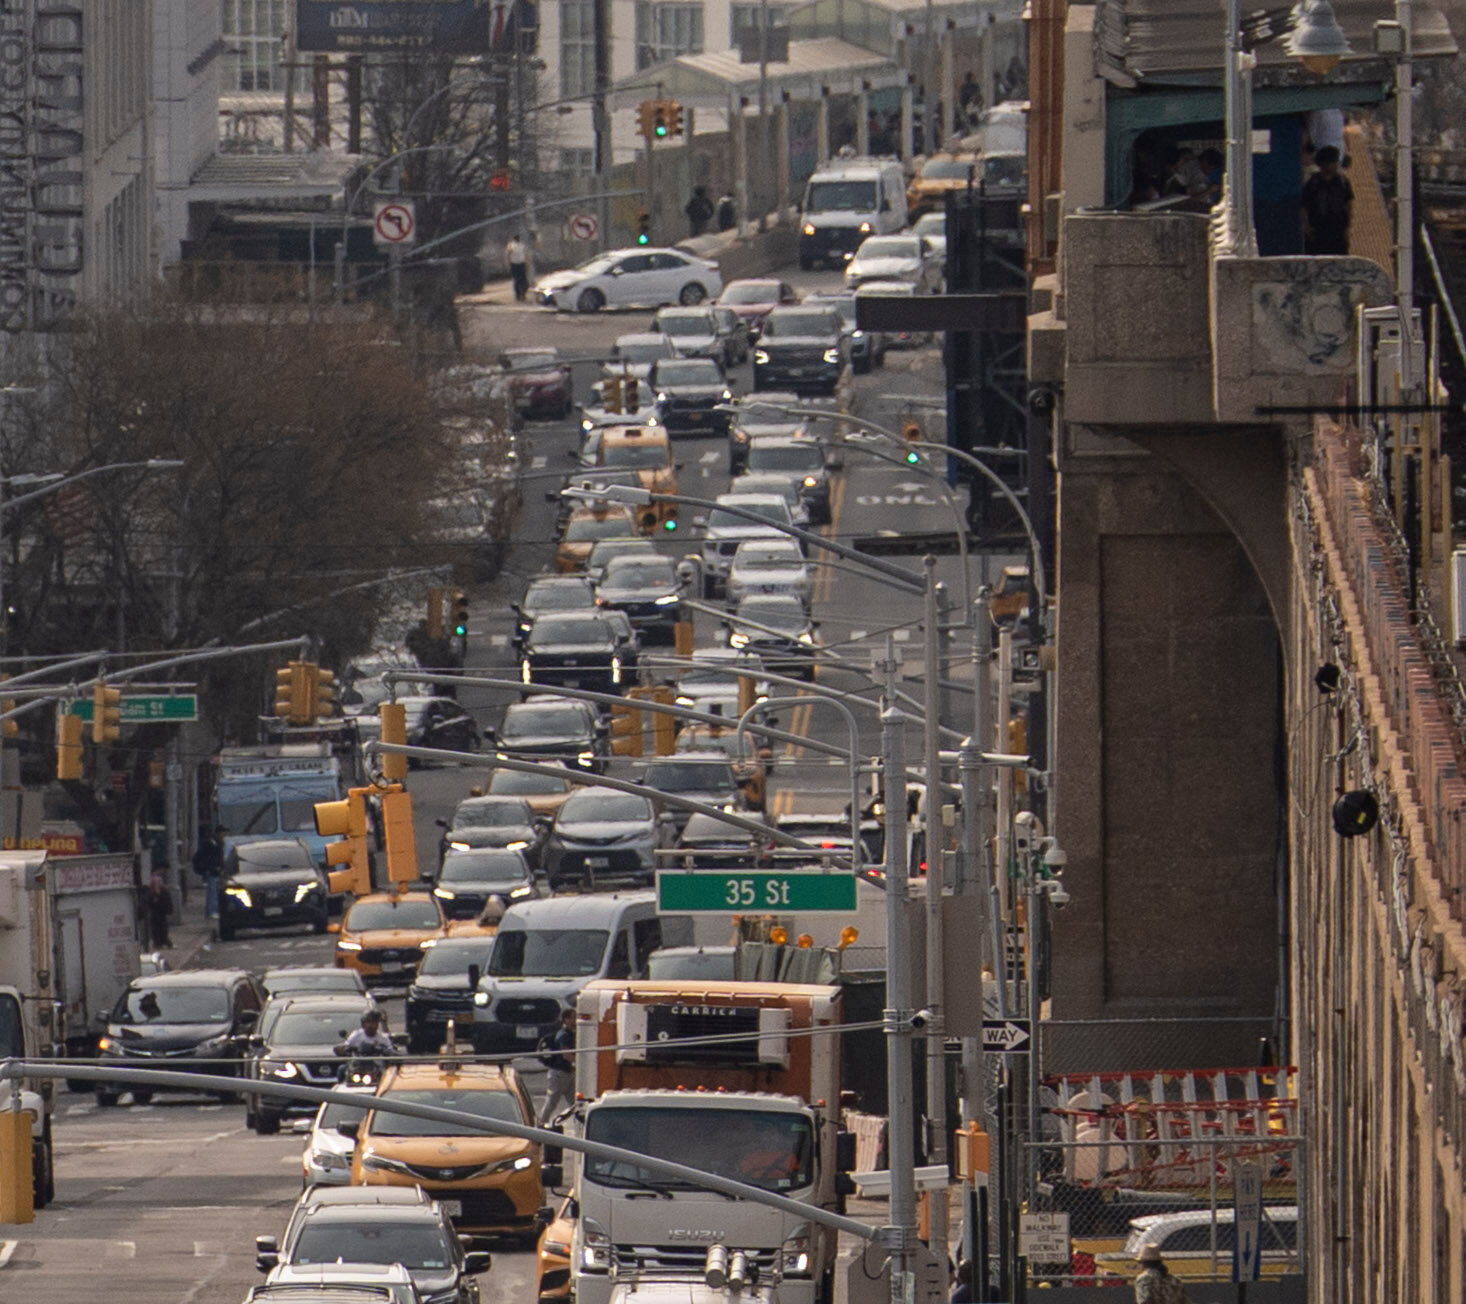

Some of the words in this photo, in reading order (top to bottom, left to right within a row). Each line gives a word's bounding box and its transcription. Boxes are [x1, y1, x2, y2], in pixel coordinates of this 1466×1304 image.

[727, 879, 756, 905] 35
[766, 879, 791, 905] St
[986, 1029, 1018, 1043] WAY
[668, 1228, 726, 1241] ISUZU
